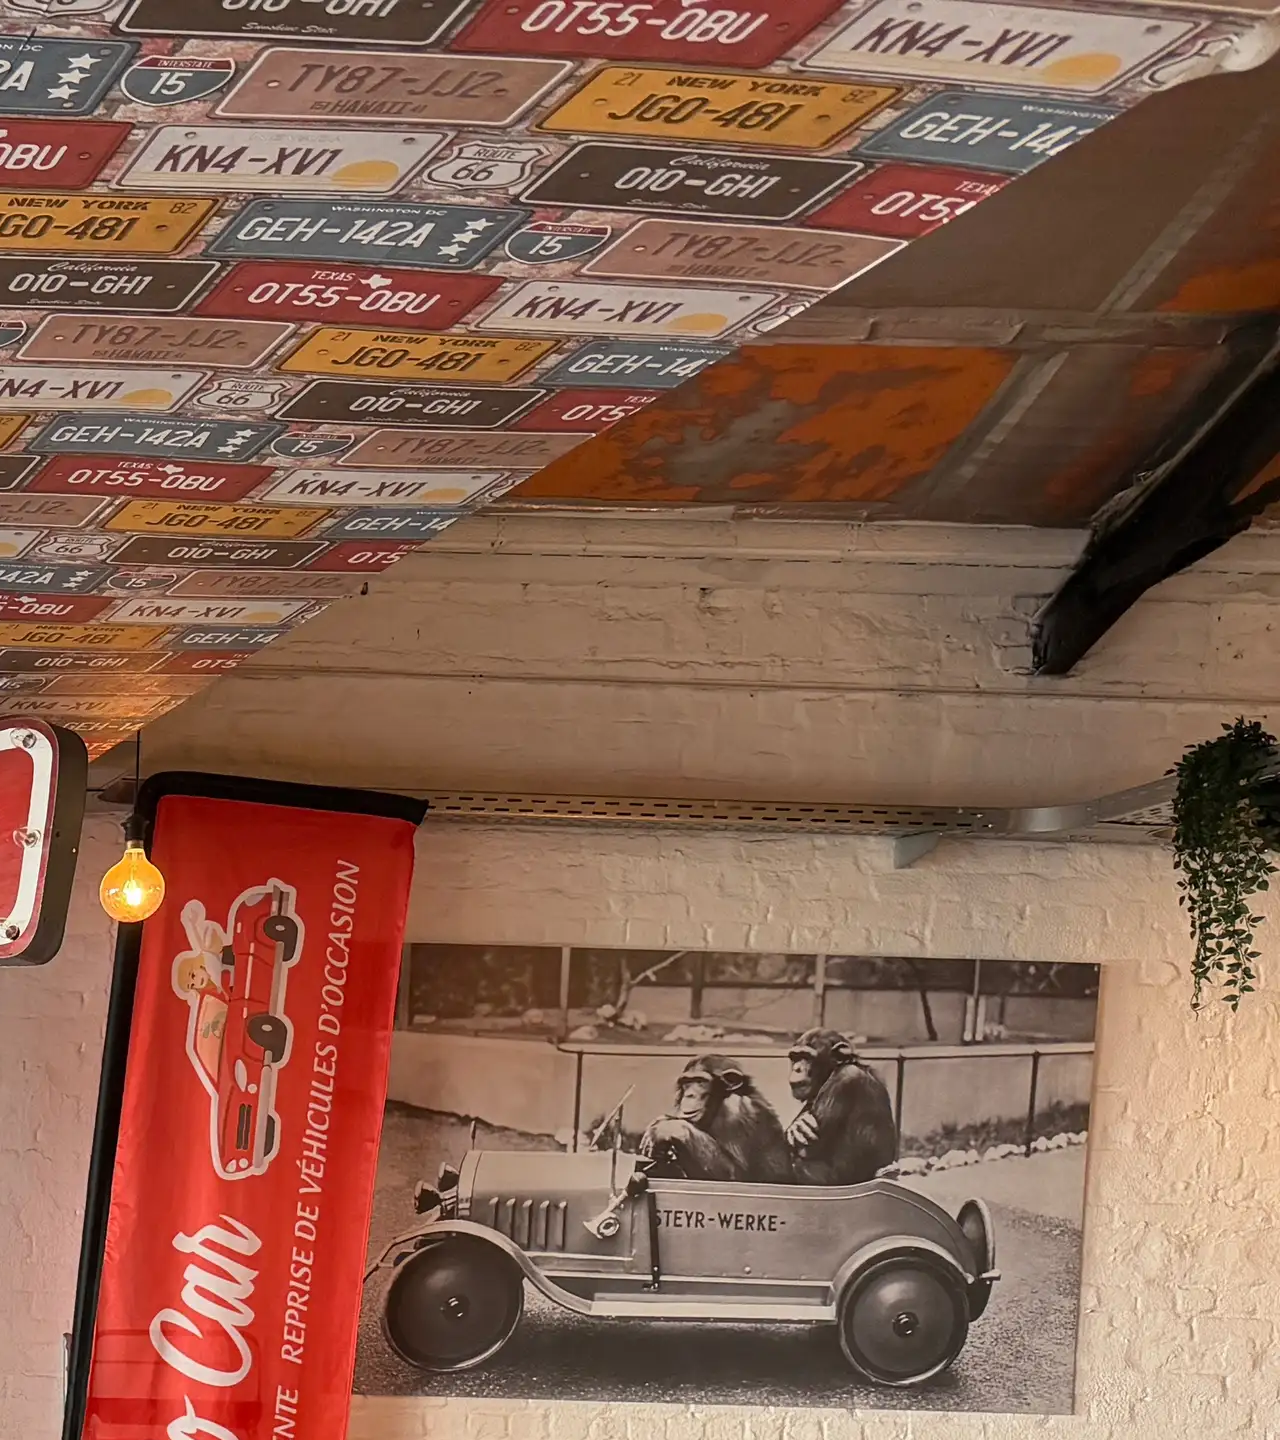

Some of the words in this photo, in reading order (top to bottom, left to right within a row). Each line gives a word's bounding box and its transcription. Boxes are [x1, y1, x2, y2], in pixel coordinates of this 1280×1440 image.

[144, 71, 197, 96] 15
[447, 160, 507, 182] 66
[230, 214, 445, 249] GEH-142A
[524, 235, 576, 255] 15
[317, 857, 362, 1036] D'OCCASION
[295, 1042, 339, 1195] VÉHICULES
[293, 1200, 320, 1241] DE
[148, 1211, 265, 1389] Car
[281, 1245, 315, 1365] REPRISE
